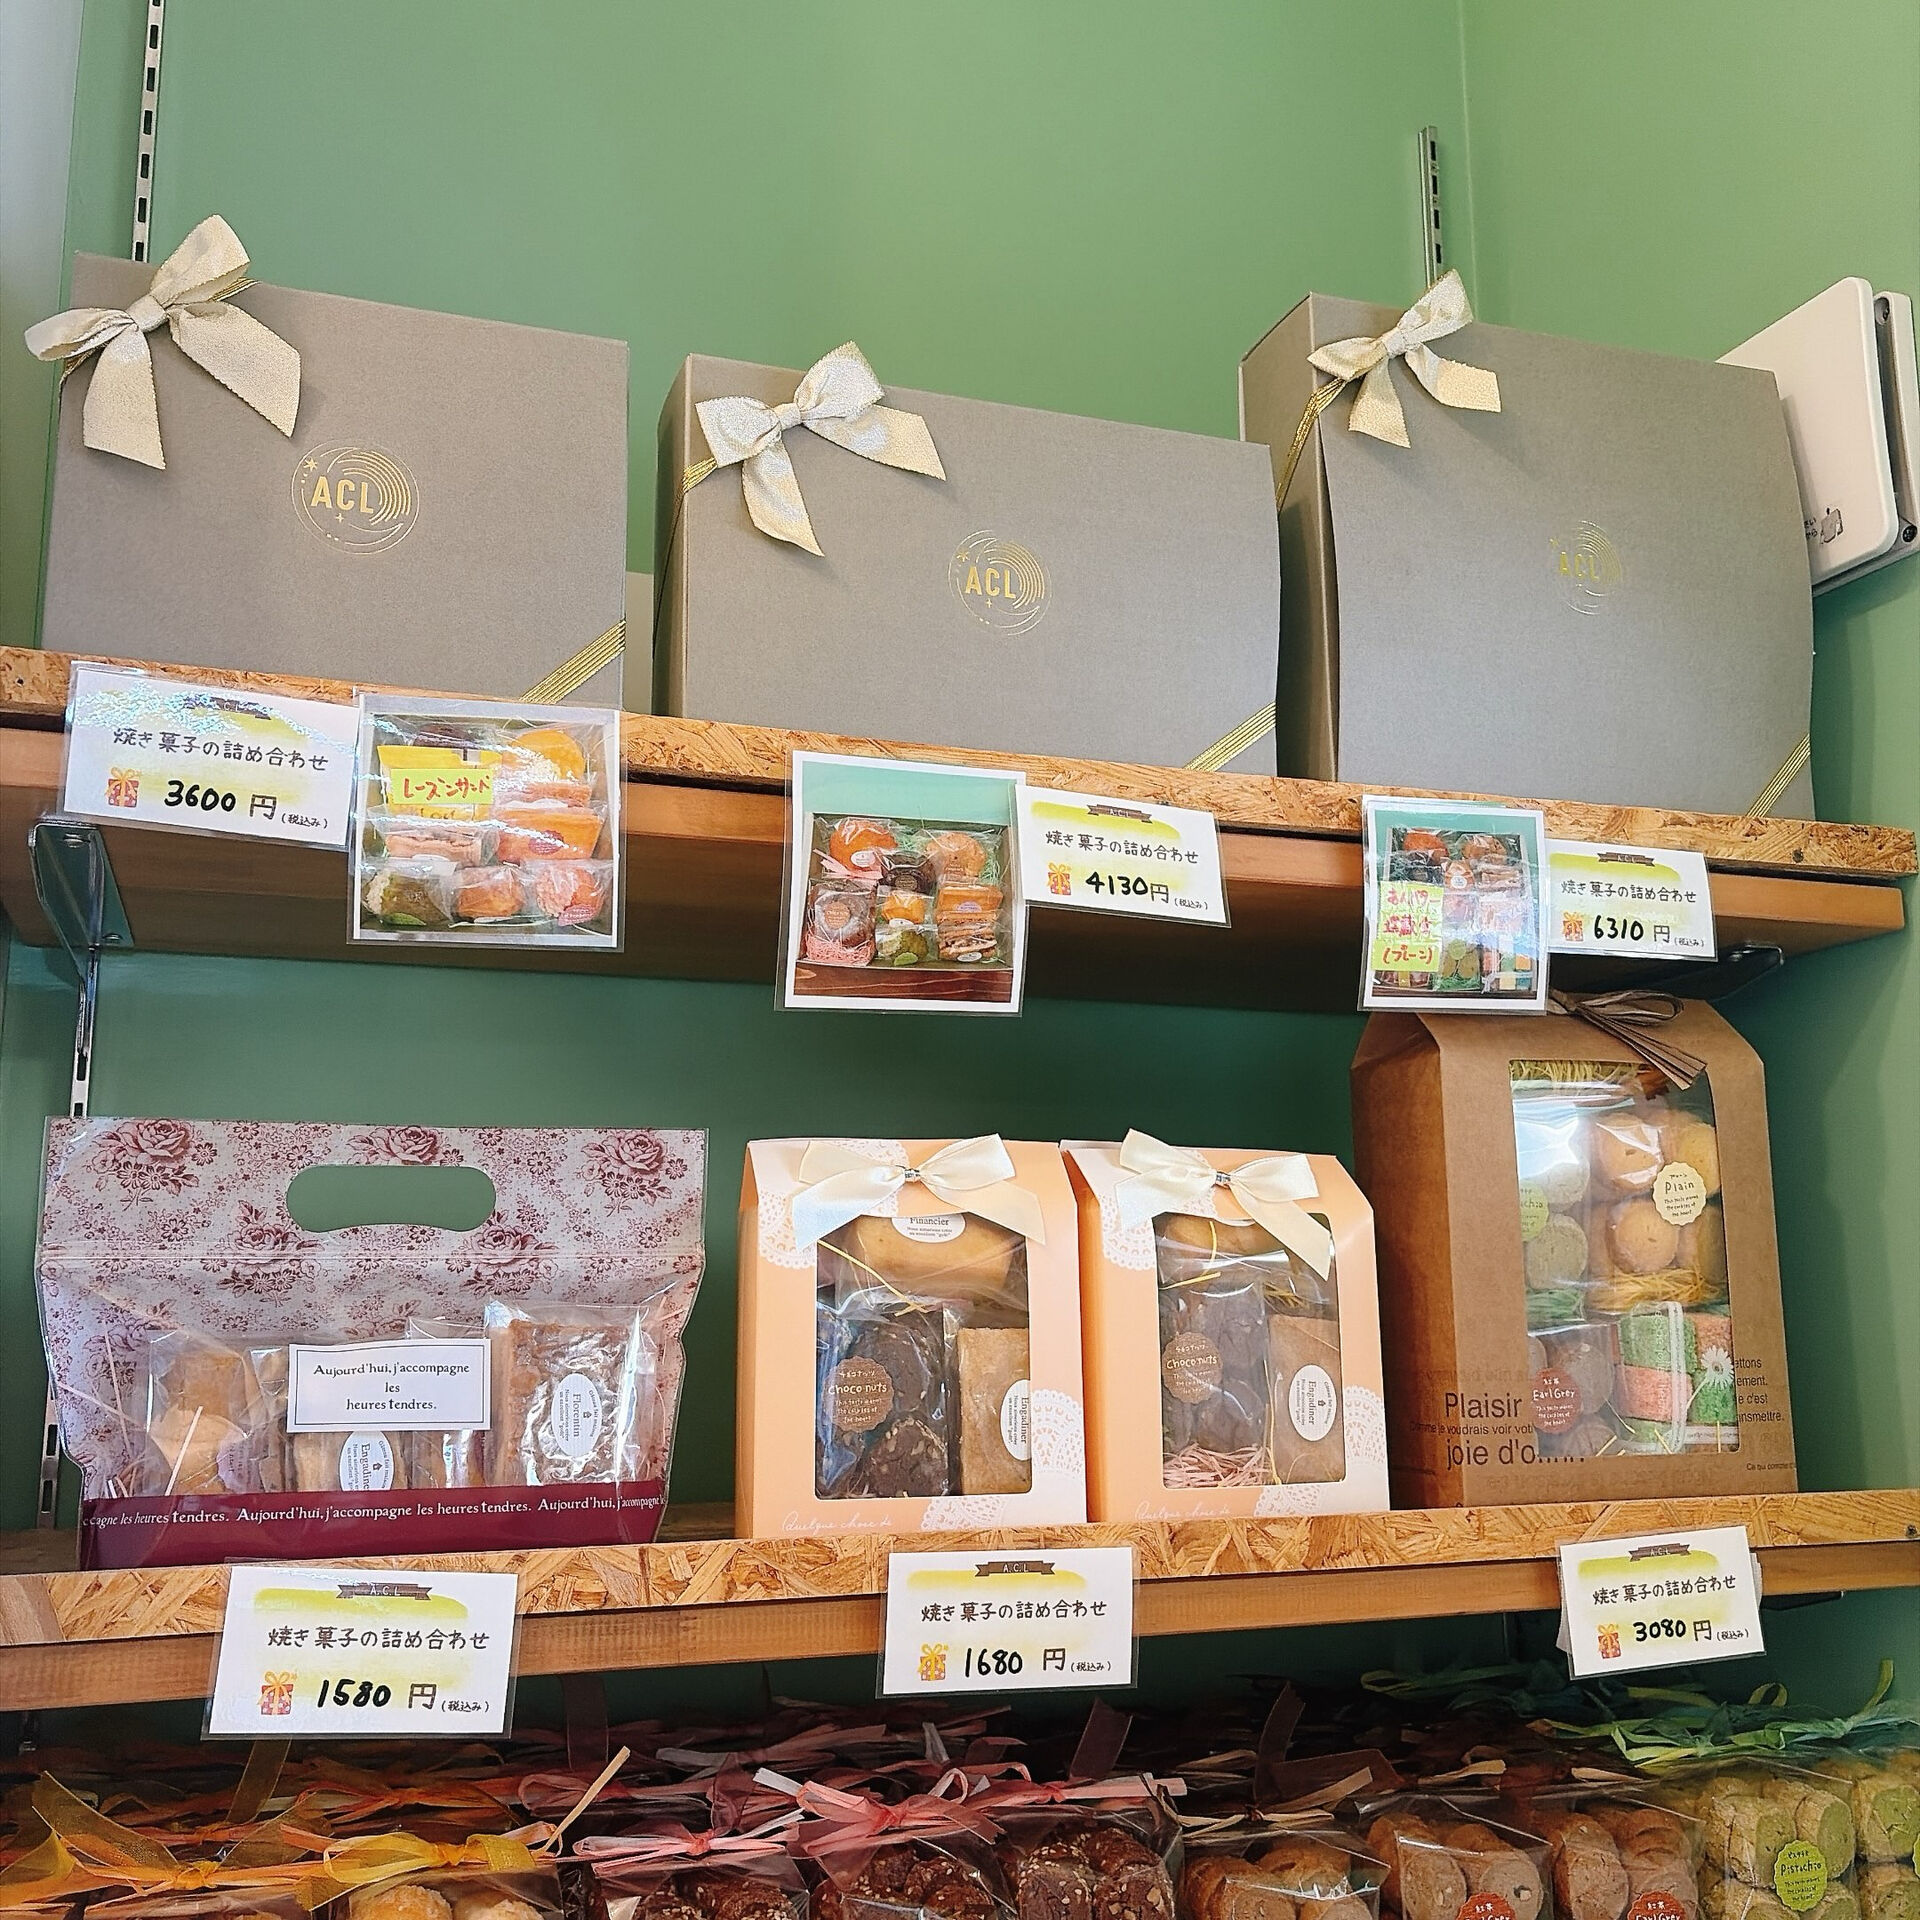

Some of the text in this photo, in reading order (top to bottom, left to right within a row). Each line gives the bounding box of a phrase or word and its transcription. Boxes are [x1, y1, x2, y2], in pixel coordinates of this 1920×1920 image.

[310, 475, 374, 514] ACL
[1558, 551, 1600, 581] ACL
[965, 566, 1016, 599] ACL
[113, 727, 329, 771] 焼き菓子の詰め合わせ
[164, 779, 236, 812] 3600
[249, 794, 277, 820] 円
[1045, 830, 1199, 864] 焼き菓子の詰め合わせ
[1085, 872, 1148, 896] 4130
[1561, 879, 1697, 903] 焼き菓子の詰め合わせ
[1594, 915, 1644, 941] 6310
[1653, 925, 1671, 944] 円
[1665, 1181, 1694, 1194] Plain
[313, 1362, 469, 1379] Aujourd'hui, j'accompagne
[1735, 1357, 1762, 1369] ettons
[385, 1382, 400, 1393] les
[1736, 1376, 1768, 1387] ement.
[346, 1399, 437, 1410] heures tendres.
[573, 1393, 582, 1437] Florentin
[1306, 1381, 1316, 1425] Engadiner
[1445, 1393, 1523, 1419] Plaisir
[1739, 1410, 1785, 1422] nsmettre.
[1447, 1424, 1489, 1435] voudrais
[1493, 1423, 1512, 1434] voir
[1515, 1423, 1534, 1434] vot
[360, 1443, 371, 1490] Engadine
[1447, 1438, 1488, 1471] joie
[134, 1512, 169, 1524] heures
[172, 1510, 230, 1523] tendres.
[236, 1507, 324, 1525] Aujourd'hui,
[325, 1505, 412, 1522] j'accompagne
[417, 1503, 433, 1515] les
[437, 1502, 479, 1515] heures
[481, 1500, 532, 1513] tendres.
[538, 1498, 616, 1514] Aujourd'hui,
[1592, 1575, 1736, 1606] 焼き菓子の詰め合わせ
[921, 1600, 1107, 1622] 焼き菓子の詰め合わせ
[267, 1626, 490, 1650] 焼き菓子の詰め合わせ
[1633, 1618, 1687, 1642] 3080
[1693, 1620, 1712, 1641] 円
[965, 1648, 1023, 1678] 1680
[1043, 1648, 1066, 1671] 円
[317, 1678, 392, 1708] 1580
[408, 1683, 437, 1709] 円
